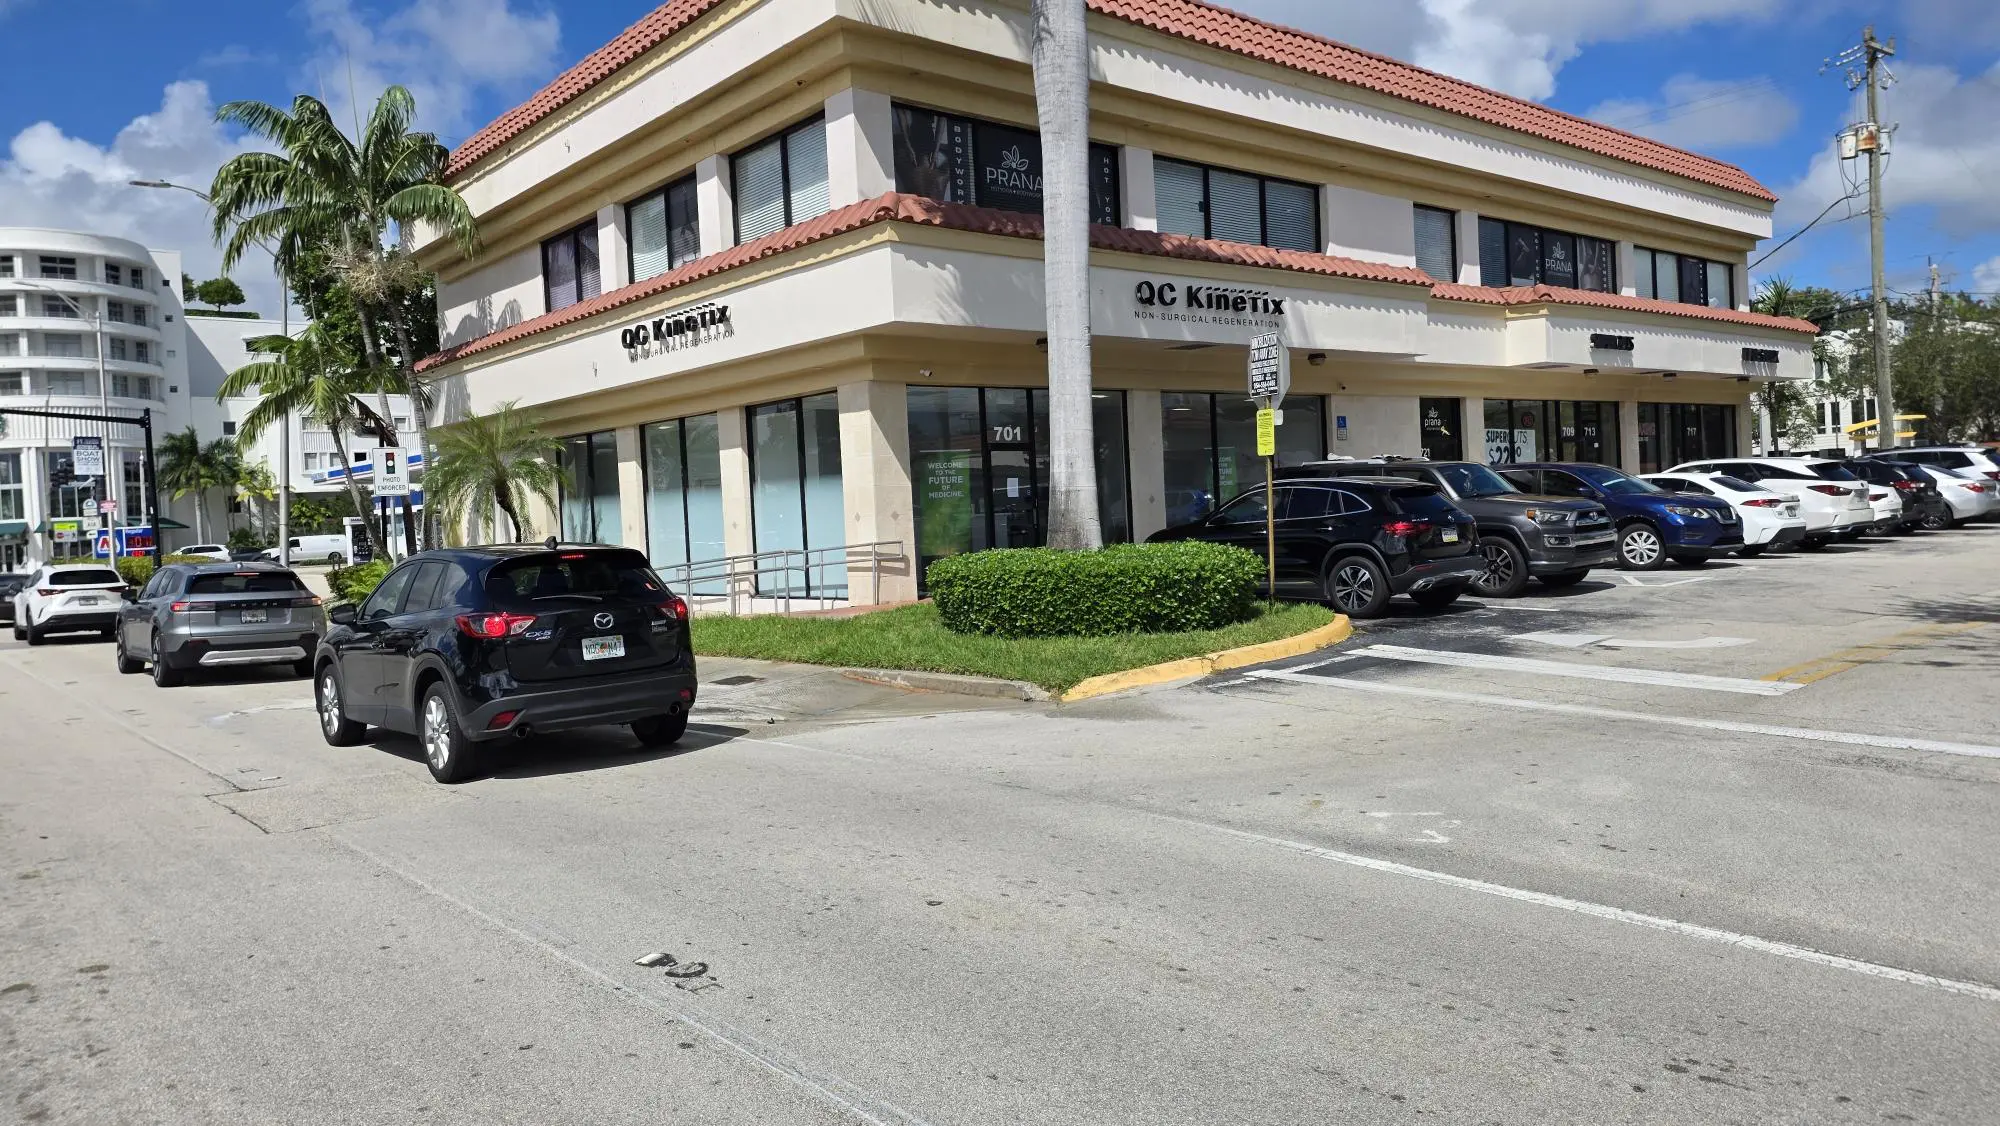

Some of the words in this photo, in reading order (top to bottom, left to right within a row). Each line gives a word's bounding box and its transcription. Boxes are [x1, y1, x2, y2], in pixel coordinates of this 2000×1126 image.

[986, 167, 1043, 191] PRANA
[1545, 259, 1573, 273] PRANA
[1135, 280, 1177, 307] QC
[1186, 285, 1285, 315] Kinetix
[1134, 311, 1209, 324] NON-SURGICAL
[1212, 316, 1280, 328] REGENERATION
[621, 324, 649, 349] QC
[1424, 418, 1441, 428] prana
[993, 426, 1021, 441] 701
[1562, 427, 1575, 437] 709
[1584, 427, 1596, 437] 713
[1686, 427, 1697, 437] 717
[927, 461, 964, 469] WELCOME
[928, 475, 964, 485] FUTURE
